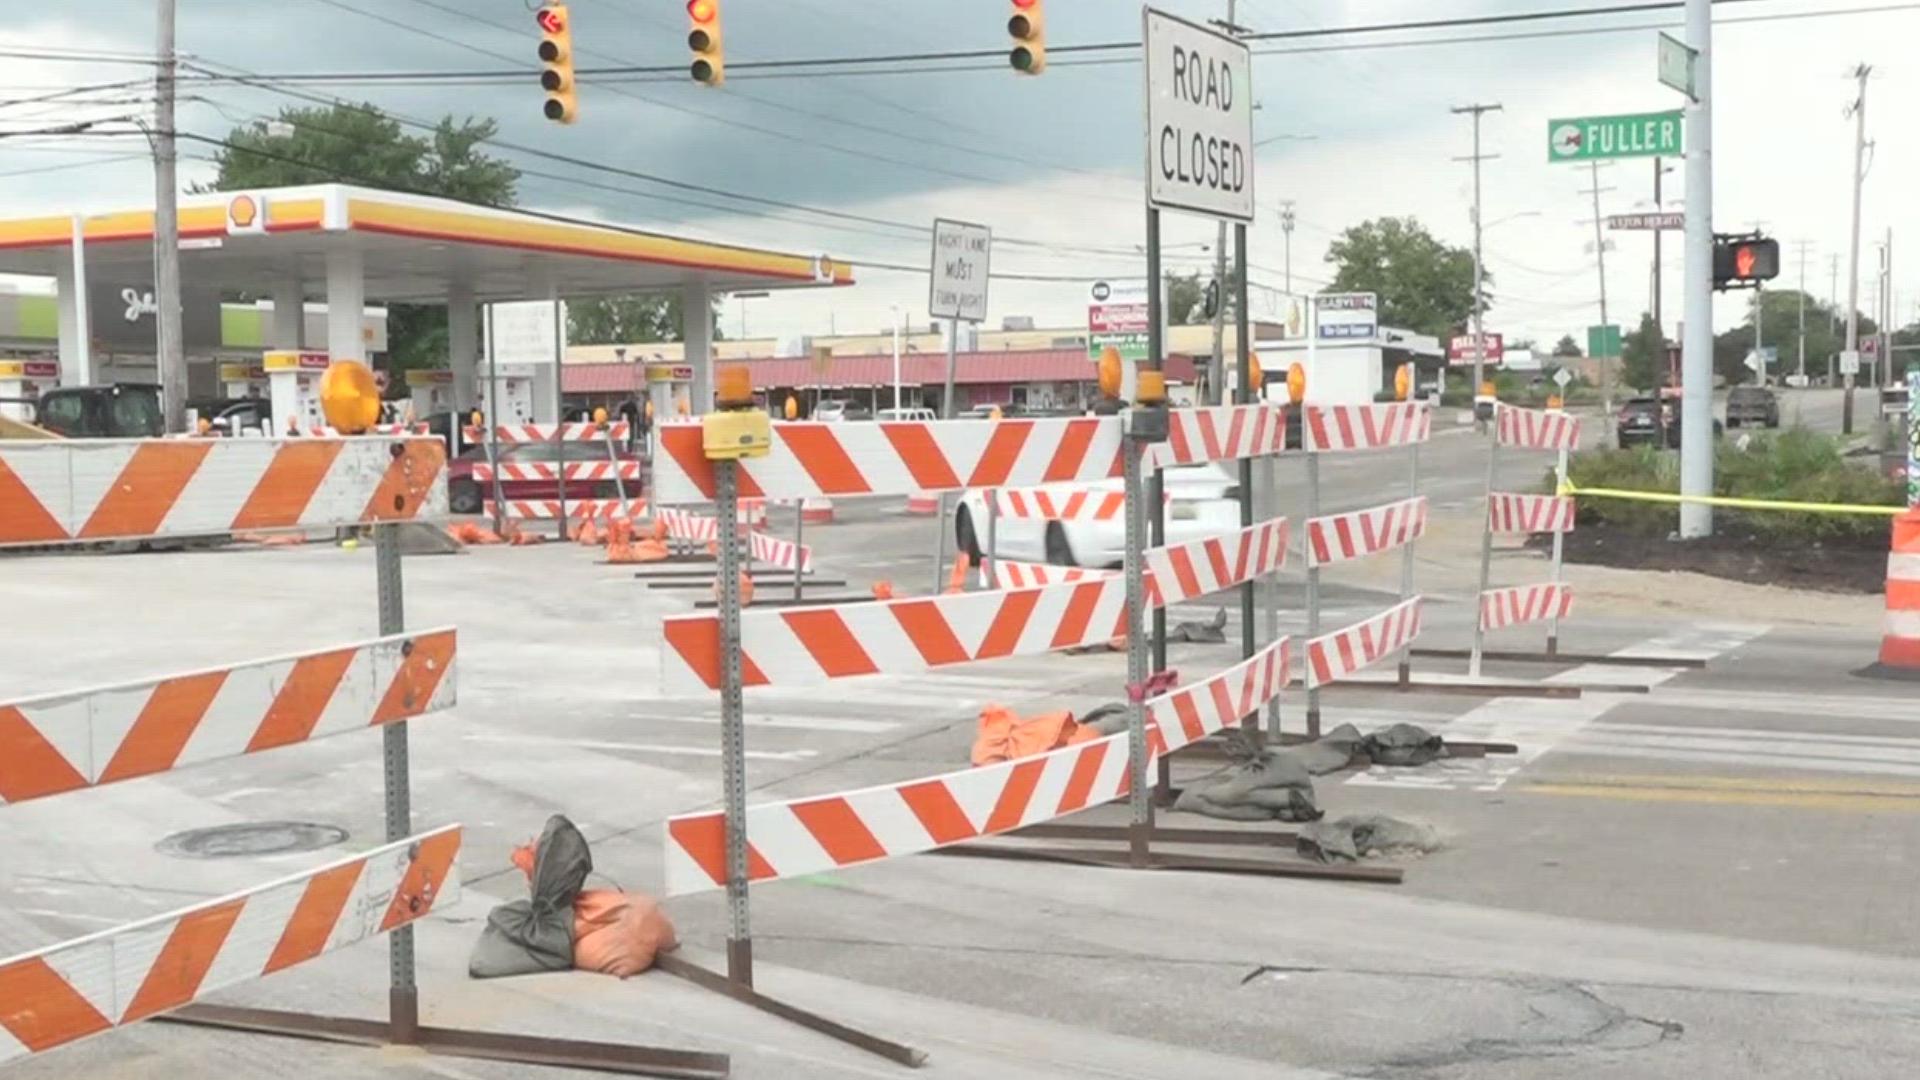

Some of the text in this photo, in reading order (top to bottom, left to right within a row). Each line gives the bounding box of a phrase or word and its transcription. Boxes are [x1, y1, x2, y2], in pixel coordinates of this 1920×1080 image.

[1173, 45, 1232, 112] ROAD
[1587, 121, 1675, 153] FULLER
[1160, 124, 1244, 193] CLOSED
[938, 232, 986, 252] RIGHT LANE
[945, 259, 973, 281] MUST
[936, 290, 982, 308] TURN RIGHT
